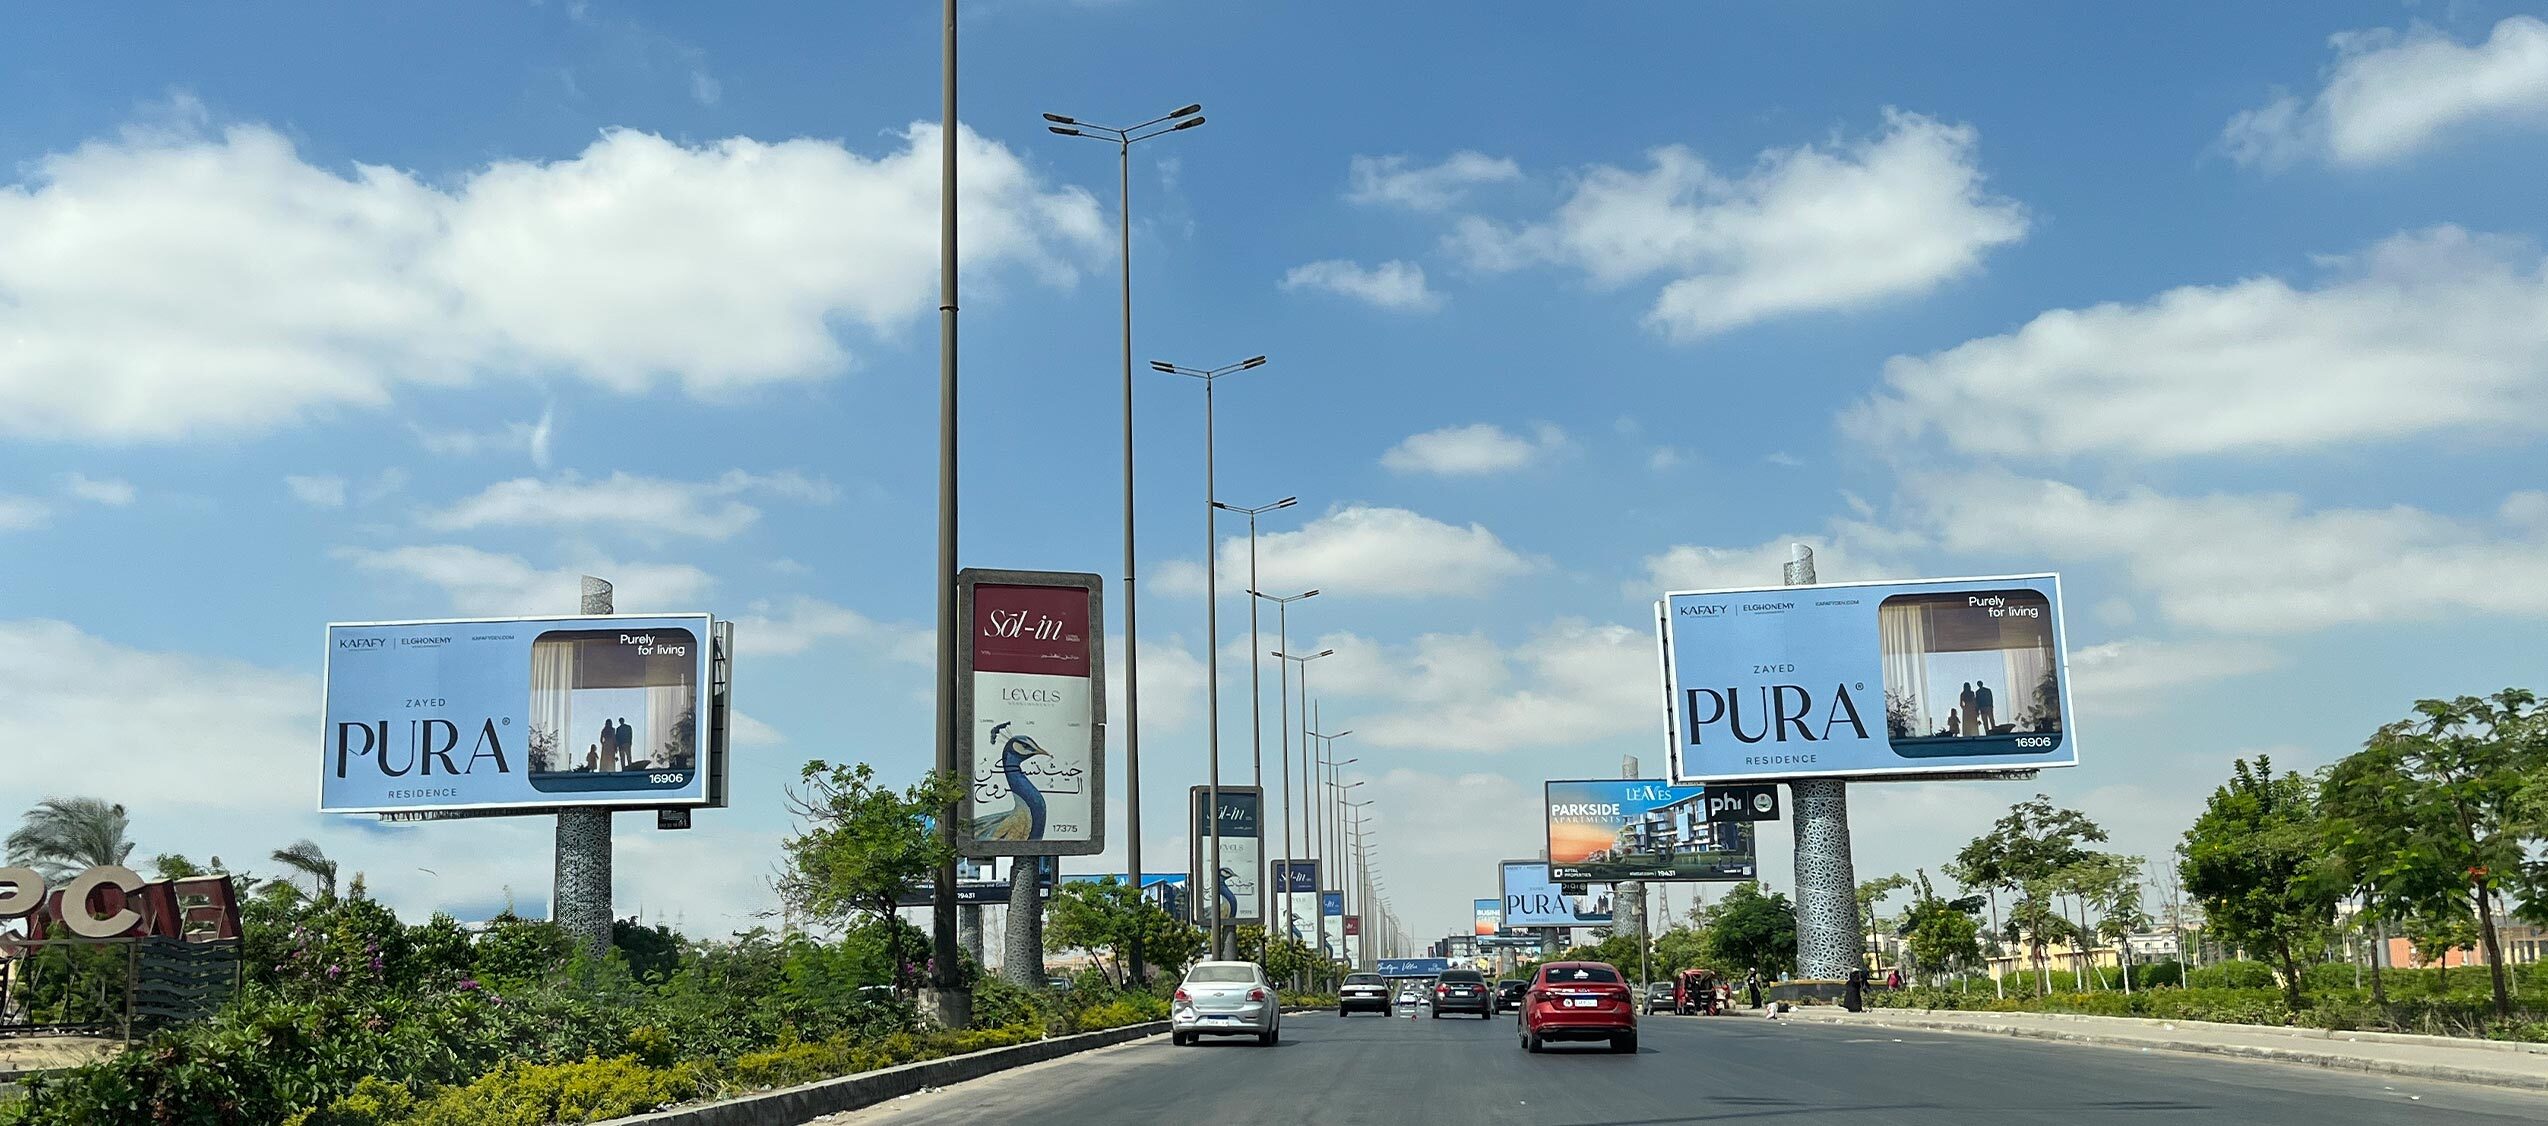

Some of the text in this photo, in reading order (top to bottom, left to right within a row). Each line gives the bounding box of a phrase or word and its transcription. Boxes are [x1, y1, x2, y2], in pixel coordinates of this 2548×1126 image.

[1968, 596, 2005, 608] Purely
[1680, 602, 1795, 616] KAFAFY ELGHONEMY
[1988, 605, 2039, 619] for living
[339, 636, 453, 649] KAFAFY ELGHONEMY
[620, 634, 656, 646] Purely
[637, 643, 686, 658] for living
[1753, 664, 1796, 674] ZAYED
[405, 698, 447, 708] ZAYED
[2014, 737, 2052, 748] 16906
[1745, 755, 1818, 766] RESIDENCE
[649, 773, 684, 785] 16906
[387, 788, 458, 799] RESIDENCE
[1551, 804, 1620, 816] PARKSIDE
[1711, 792, 1742, 817] phi
[1553, 816, 1620, 825] APARTMENTS
[1507, 893, 1568, 916] PURA
